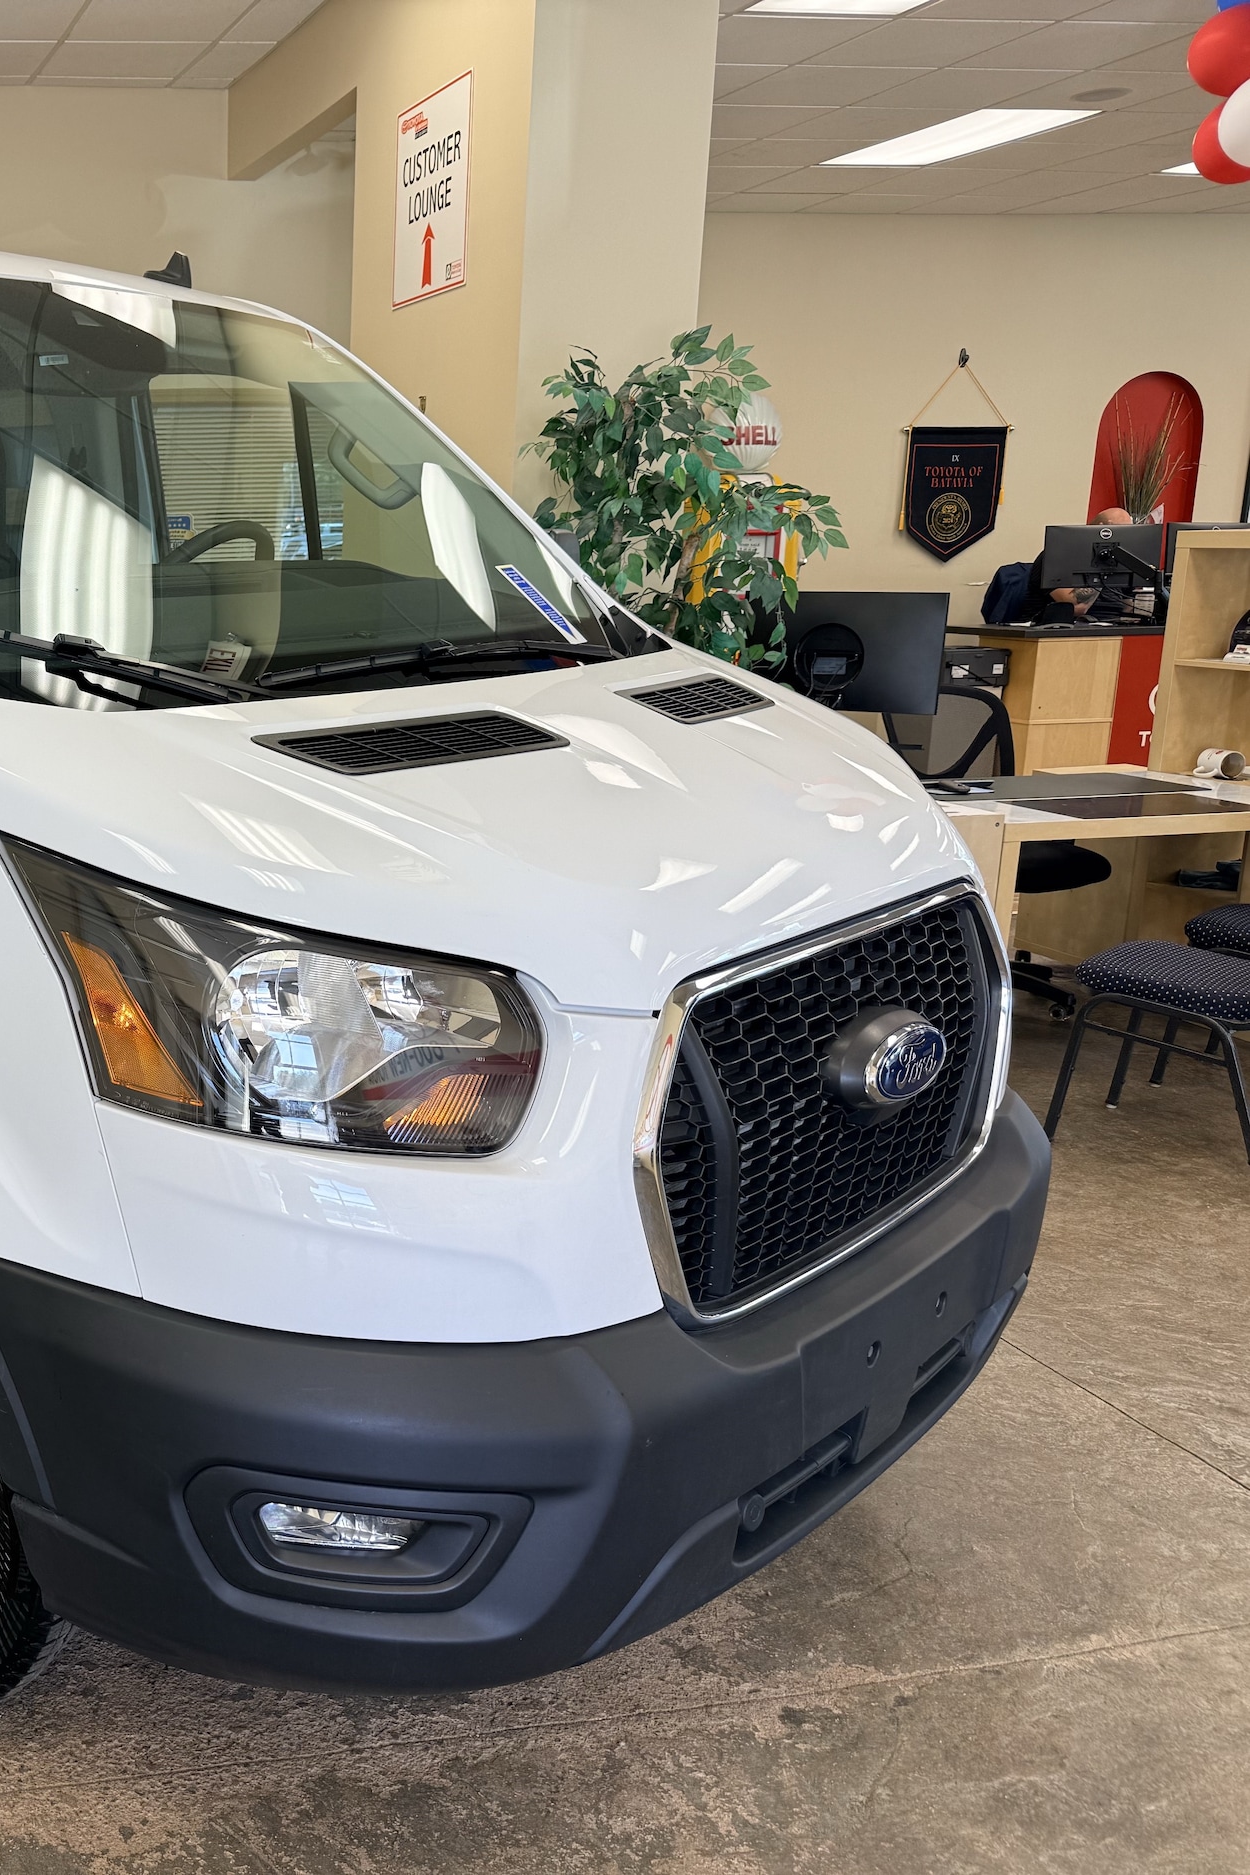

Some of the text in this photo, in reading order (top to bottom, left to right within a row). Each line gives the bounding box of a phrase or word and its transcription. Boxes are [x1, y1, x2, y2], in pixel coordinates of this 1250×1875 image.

[402, 130, 462, 188] CUSTOMER
[408, 176, 452, 225] LOUNGE
[924, 466, 984, 477] TOYOTA OF
[951, 454, 960, 463] IX
[930, 477, 974, 488] BATAVIA
[896, 1038, 938, 1090] Ford
